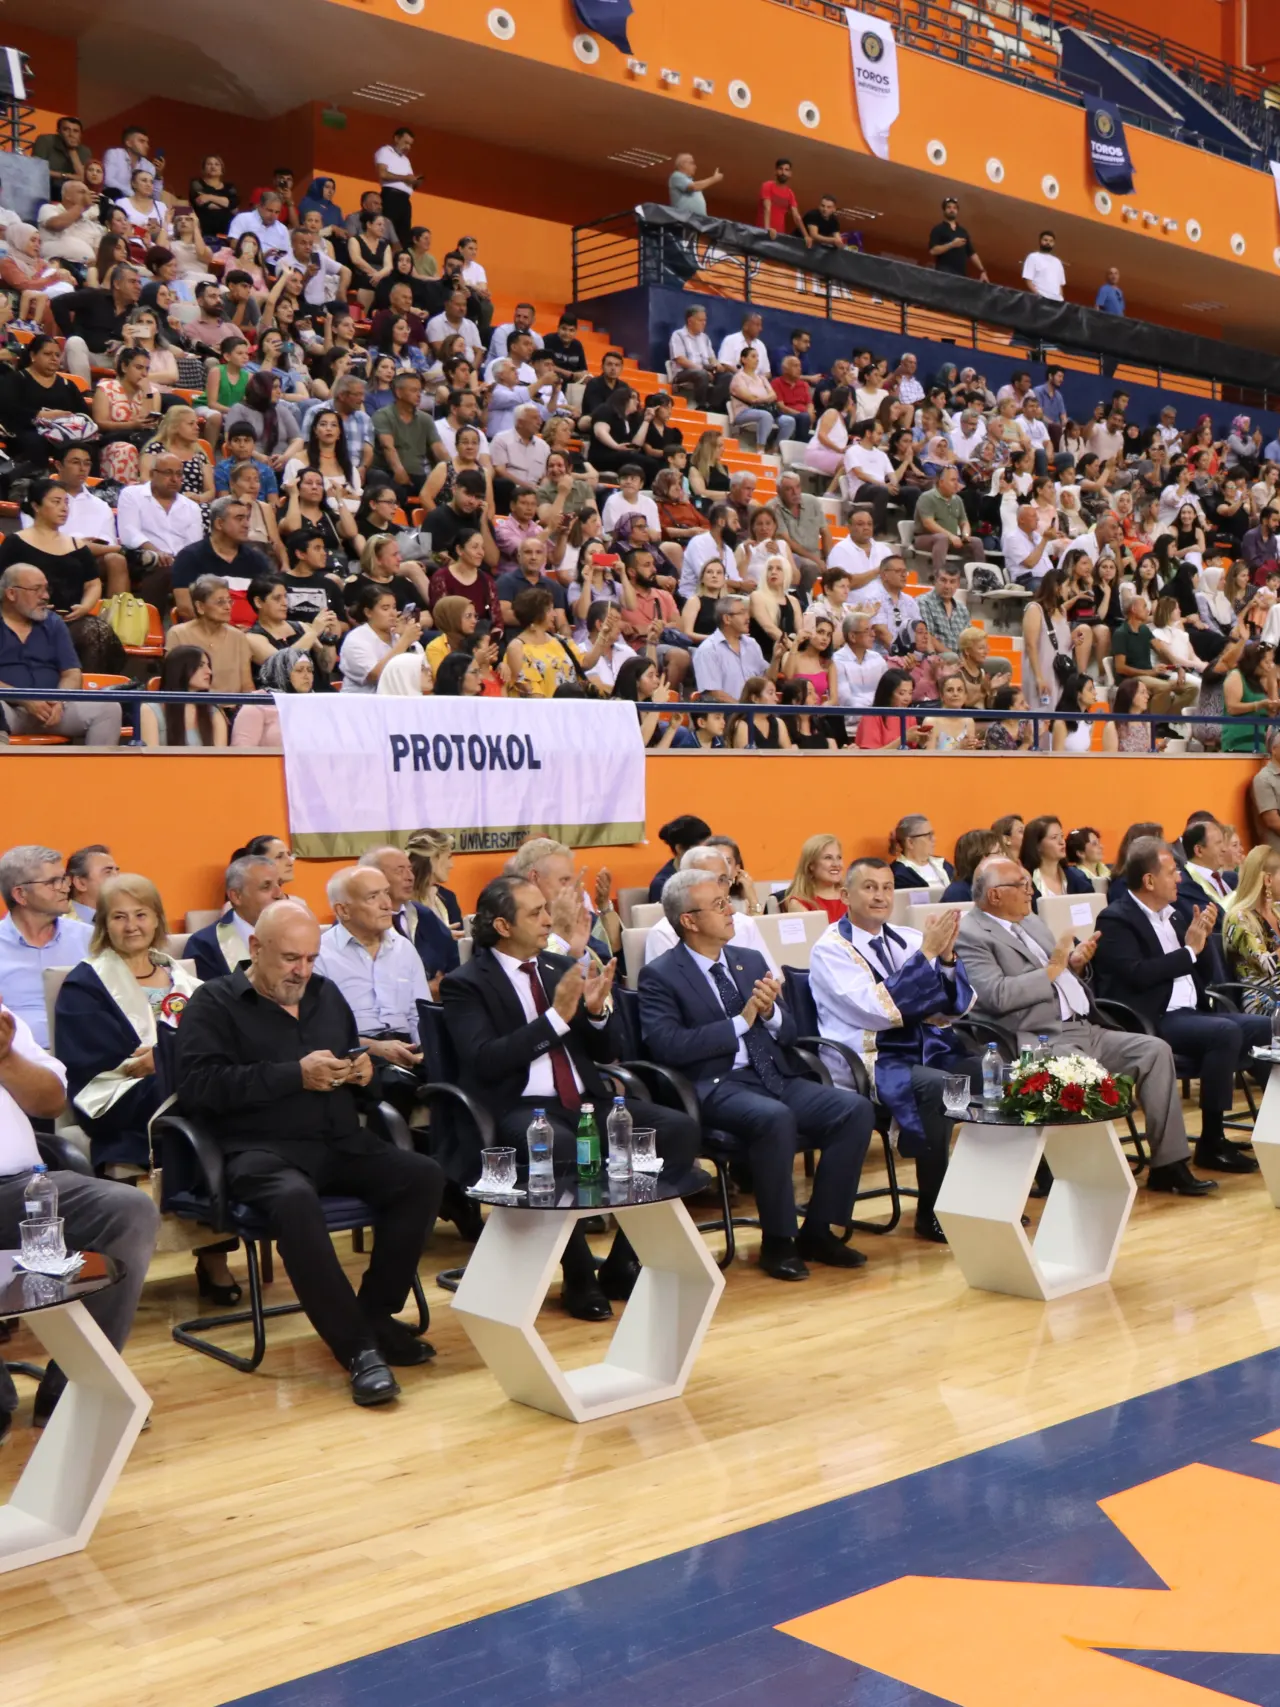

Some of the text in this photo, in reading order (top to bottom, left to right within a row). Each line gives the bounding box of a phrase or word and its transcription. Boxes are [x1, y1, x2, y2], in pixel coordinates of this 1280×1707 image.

[856, 67, 889, 85] TOROS
[1091, 140, 1123, 156] TOROS
[389, 734, 541, 772] PROTOKOL
